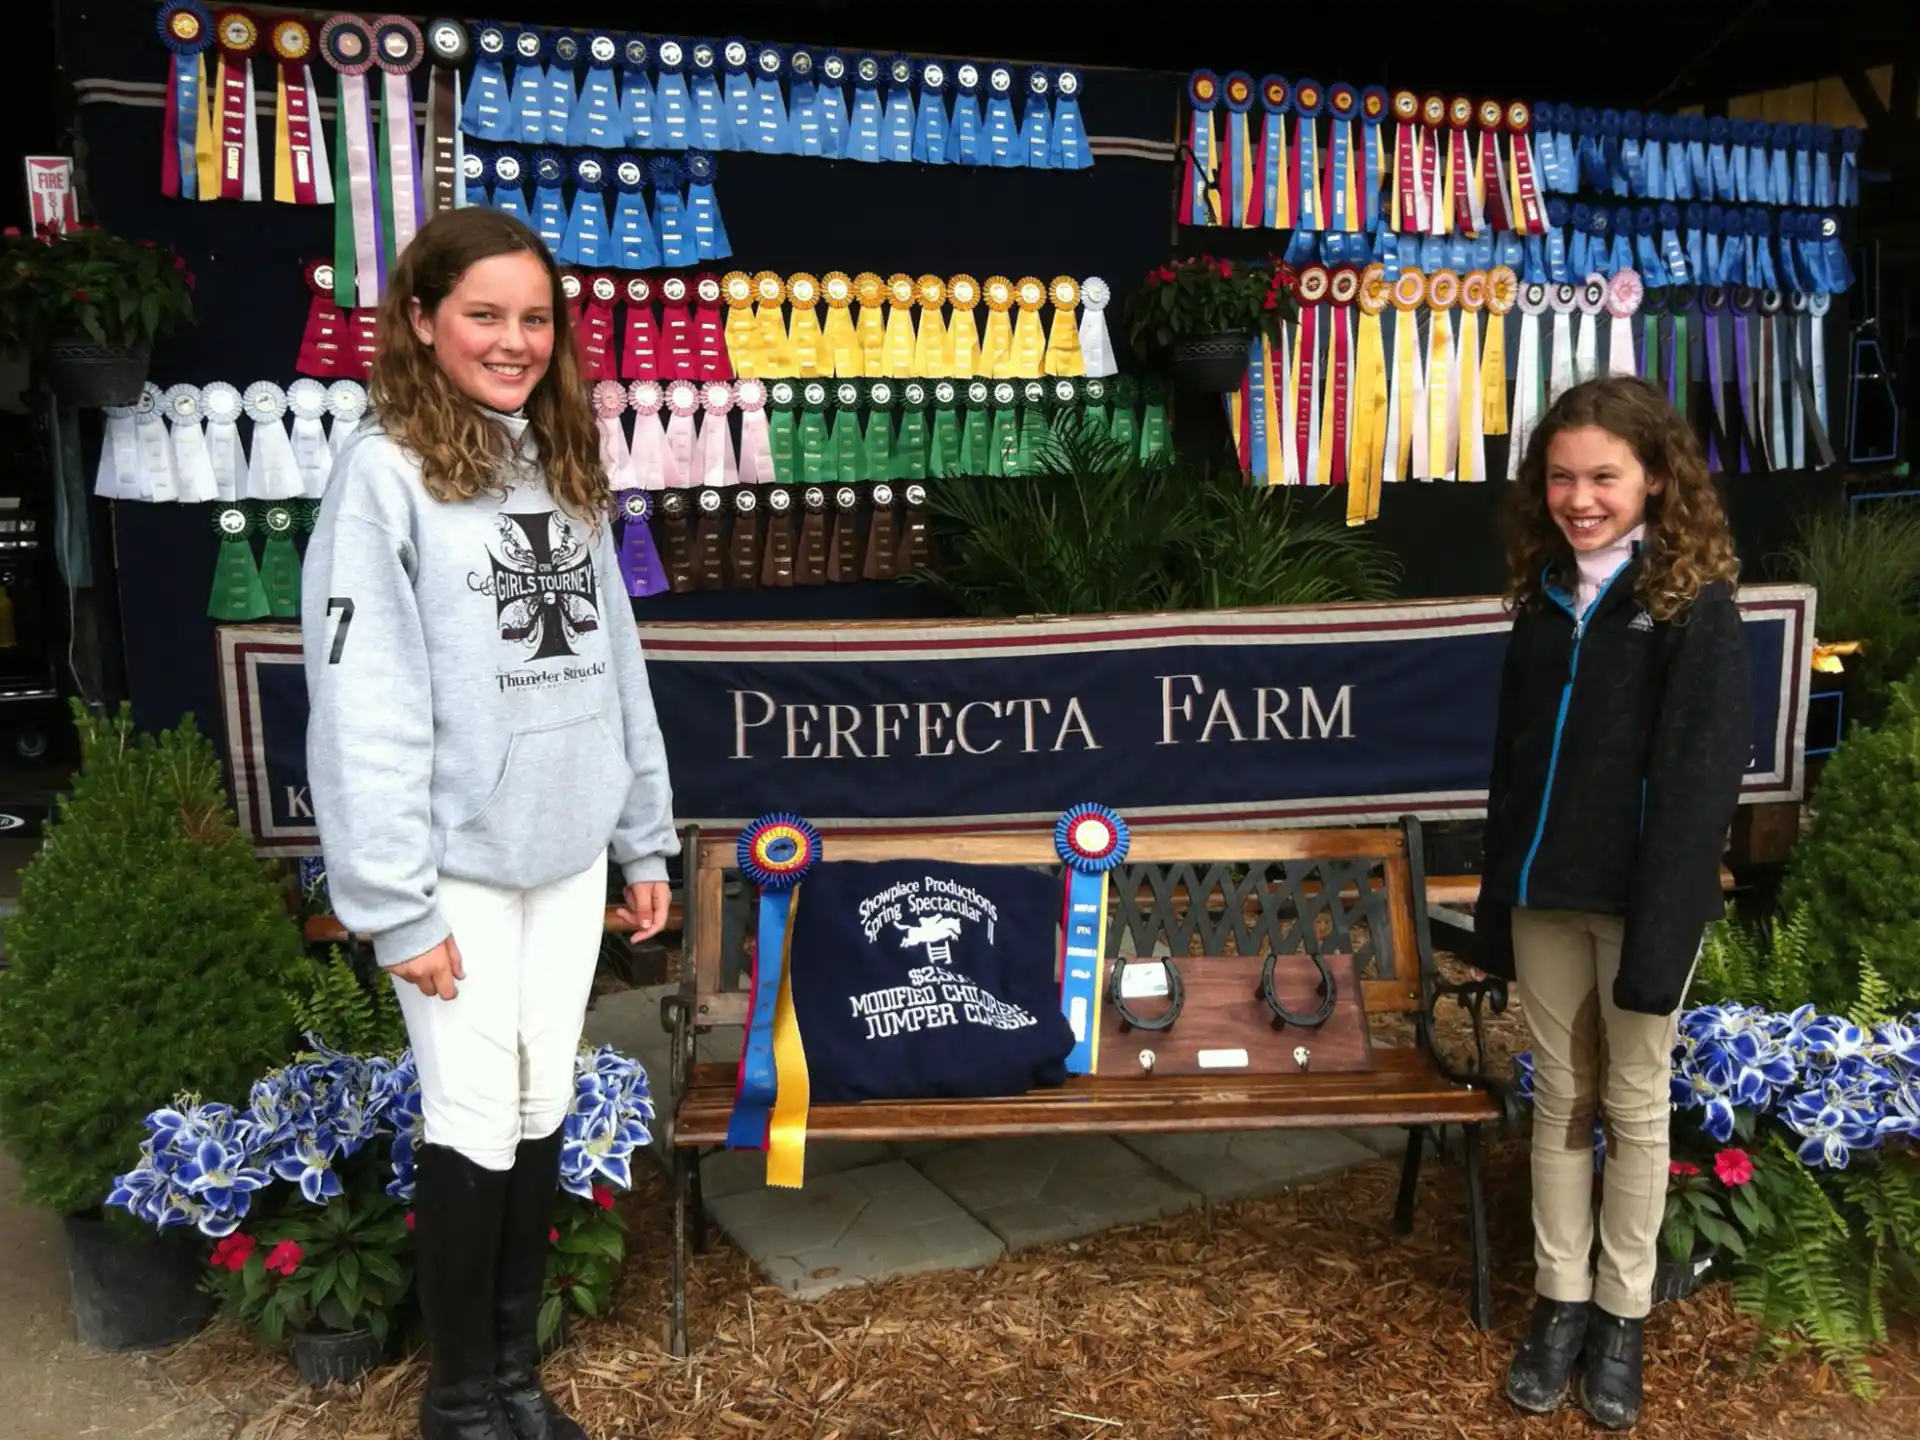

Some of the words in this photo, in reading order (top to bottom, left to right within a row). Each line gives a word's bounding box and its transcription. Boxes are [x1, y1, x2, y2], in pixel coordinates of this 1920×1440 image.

[38, 172, 64, 189] FIRE
[495, 570, 536, 601] GIRLS
[537, 563, 592, 594] TOURNEY
[326, 597, 355, 665] 7
[496, 670, 561, 693] Thunder
[563, 662, 606, 681] Struck!
[726, 689, 1103, 760] PERFECTA
[1155, 674, 1356, 745] FARM
[859, 881, 920, 925] Showplace
[925, 876, 998, 921] Productions
[864, 903, 903, 944] Spring
[908, 894, 982, 924] Spectacular
[849, 985, 937, 1018] MODIFIED
[865, 1003, 959, 1040] JUMPER
[963, 1003, 1038, 1031] CLASSIC
